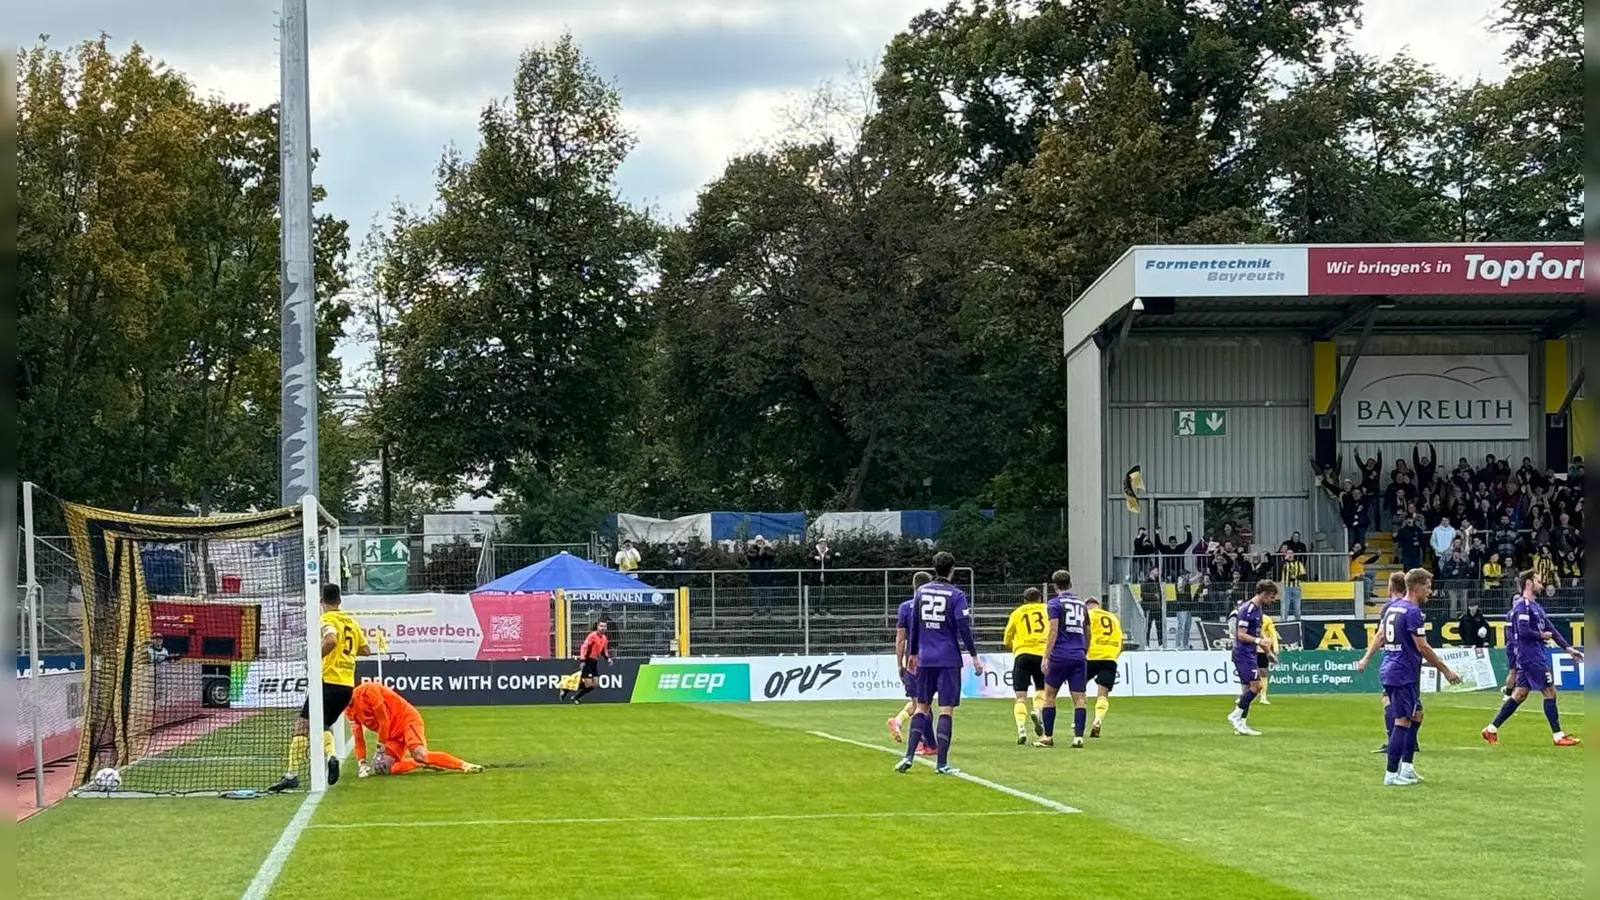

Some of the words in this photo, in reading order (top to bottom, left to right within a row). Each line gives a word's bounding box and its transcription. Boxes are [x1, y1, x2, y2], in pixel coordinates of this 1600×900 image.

[1145, 257, 1272, 270] Formentechnik
[1326, 261, 1354, 274] Wir
[1436, 260, 1452, 273] in
[1464, 252, 1584, 287] Topfor
[1207, 271, 1285, 282] Bayreuth
[1357, 399, 1513, 427] BAYREUTH
[921, 595, 946, 622] 22
[1064, 603, 1085, 627] 24
[396, 623, 480, 637] Bewerben.
[1021, 612, 1045, 635] 13
[1100, 616, 1113, 636] 9
[1385, 613, 1395, 642] 6
[342, 625, 353, 656] 5
[852, 668, 878, 679] only
[1146, 661, 1241, 685] brands
[1252, 669, 1259, 680] 7
[1268, 662, 1290, 671] Dein
[1292, 661, 1322, 671] Kurier.
[1324, 660, 1360, 671] Überall
[282, 678, 308, 692] ce
[448, 675, 492, 690] WITH
[497, 674, 623, 689] COMPRON
[681, 673, 725, 693] cep
[764, 658, 845, 699] OPUS
[853, 680, 901, 691] togethe
[1269, 674, 1293, 684] Auch
[1296, 674, 1309, 684] als
[1312, 674, 1353, 686] E-Paper.
[1545, 672, 1553, 683] 3
